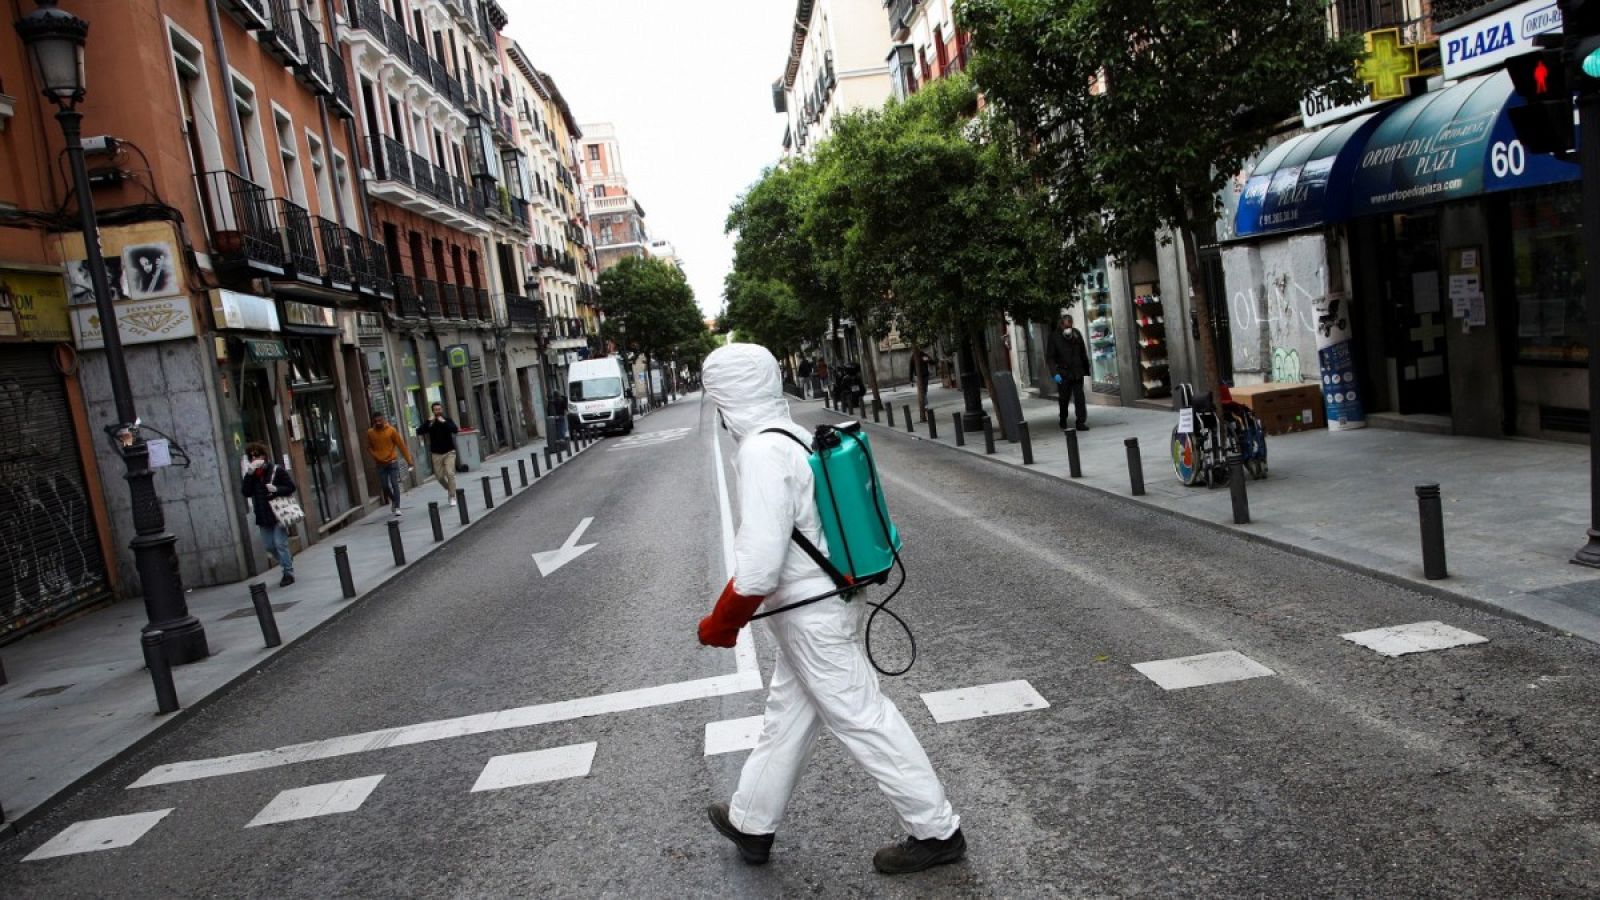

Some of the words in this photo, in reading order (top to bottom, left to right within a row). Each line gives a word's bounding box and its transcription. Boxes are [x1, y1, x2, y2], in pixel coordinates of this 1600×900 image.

[1447, 20, 1515, 65] PLAZA
[1362, 136, 1437, 169] ORTOPEDIA
[1414, 148, 1457, 177] PLAZA
[1490, 139, 1526, 178] 60
